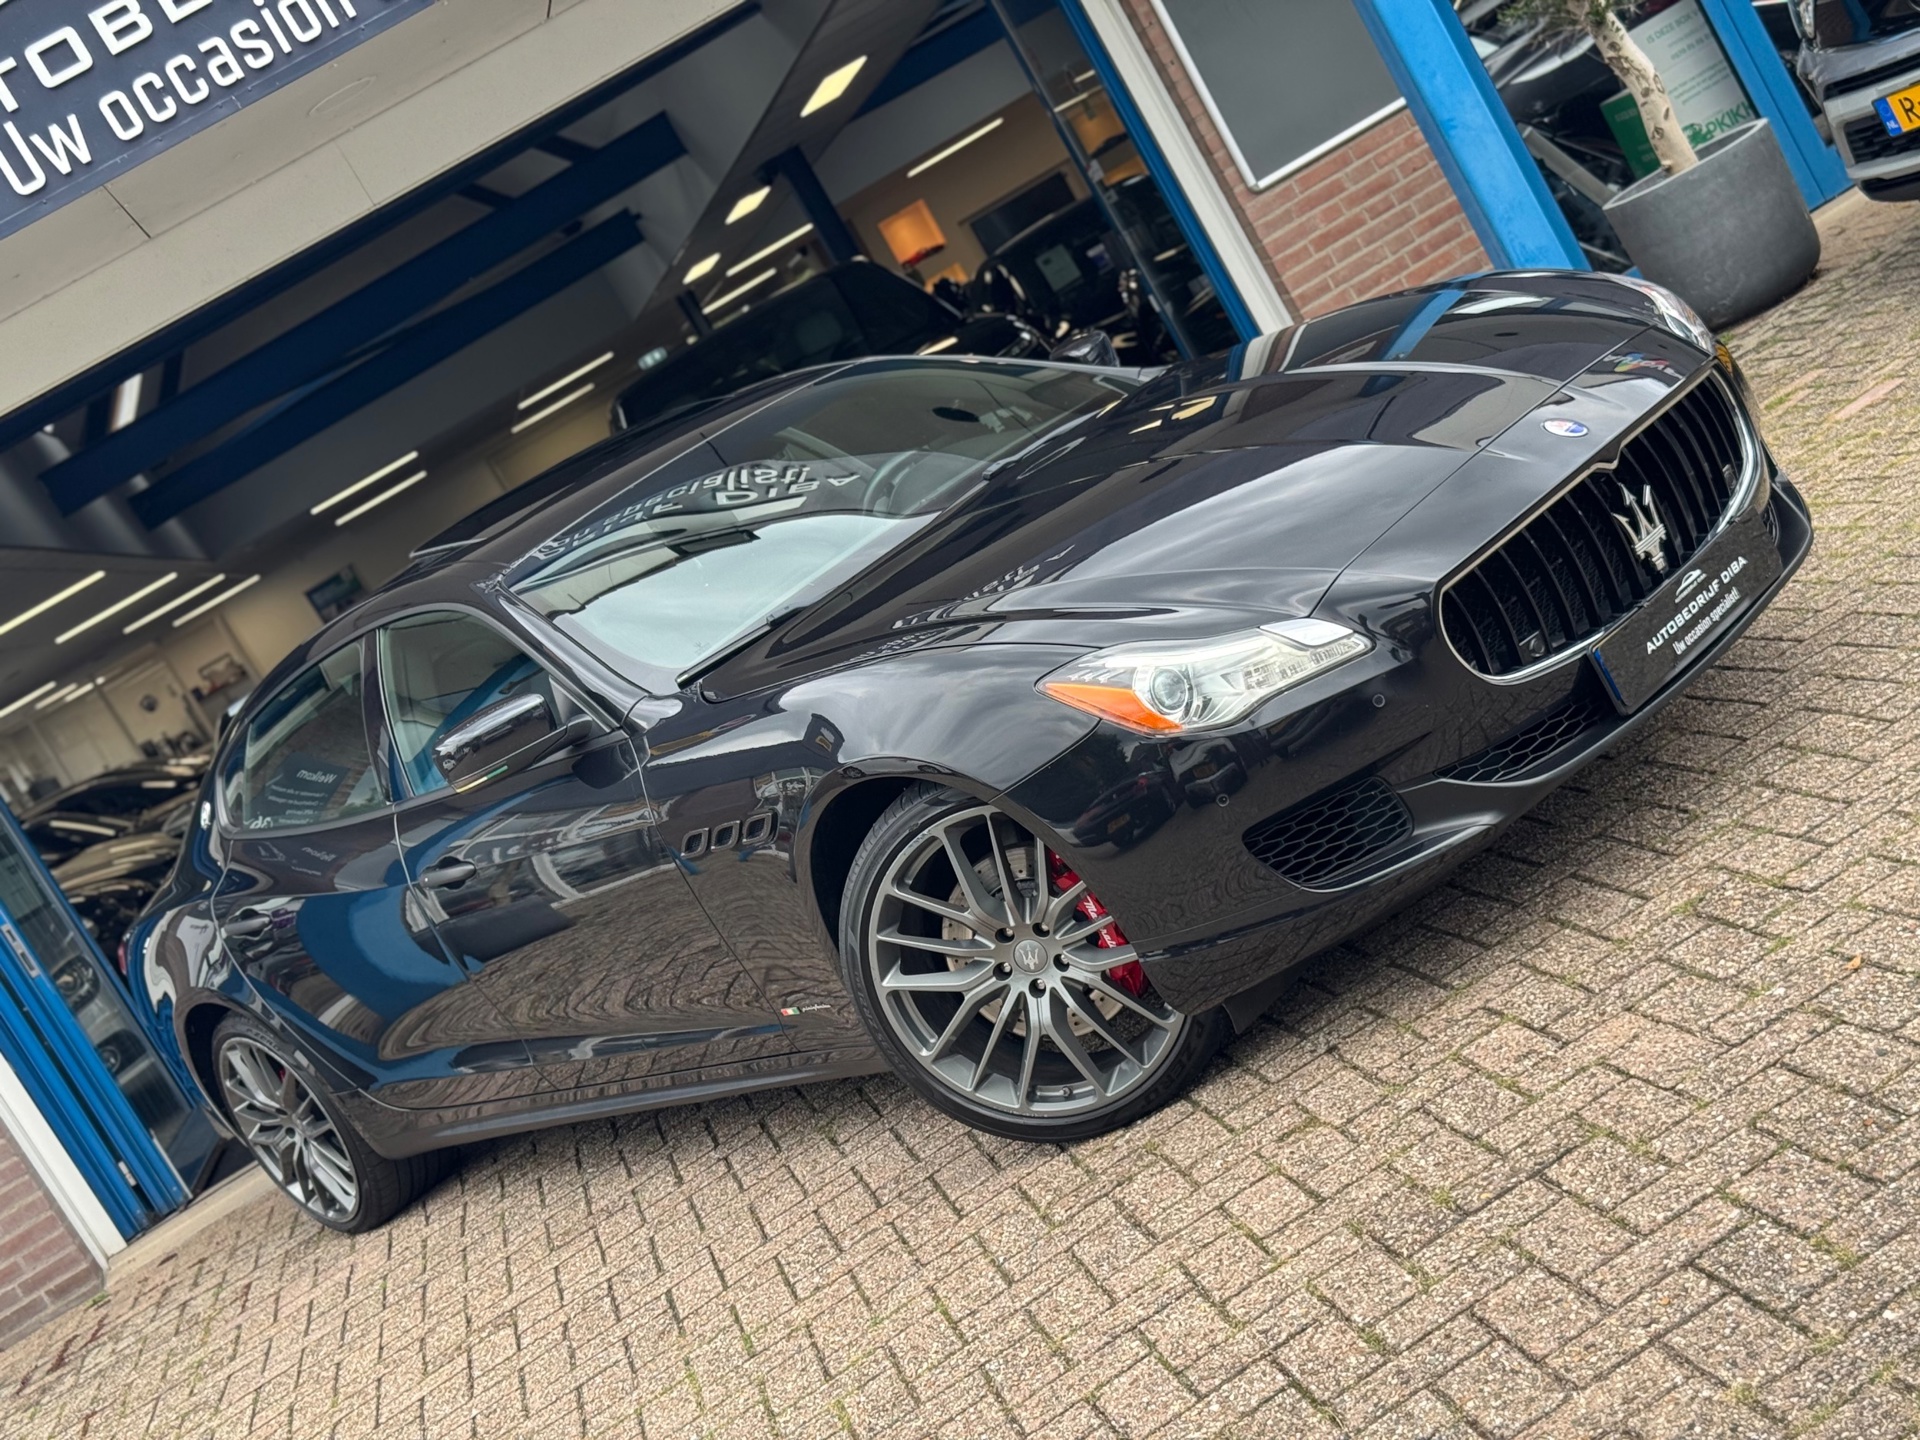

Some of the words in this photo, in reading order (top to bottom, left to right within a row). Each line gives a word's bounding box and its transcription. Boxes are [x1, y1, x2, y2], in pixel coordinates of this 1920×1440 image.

[0, 113, 92, 196] Uw
[98, 0, 357, 141] occasion
[1646, 578, 1720, 655] AUTOBEDRIJF
[1720, 556, 1748, 584] DIBA
[1672, 641, 1687, 655] Uw
[1684, 616, 1713, 645] occasion
[1710, 586, 1741, 621] specialist!
